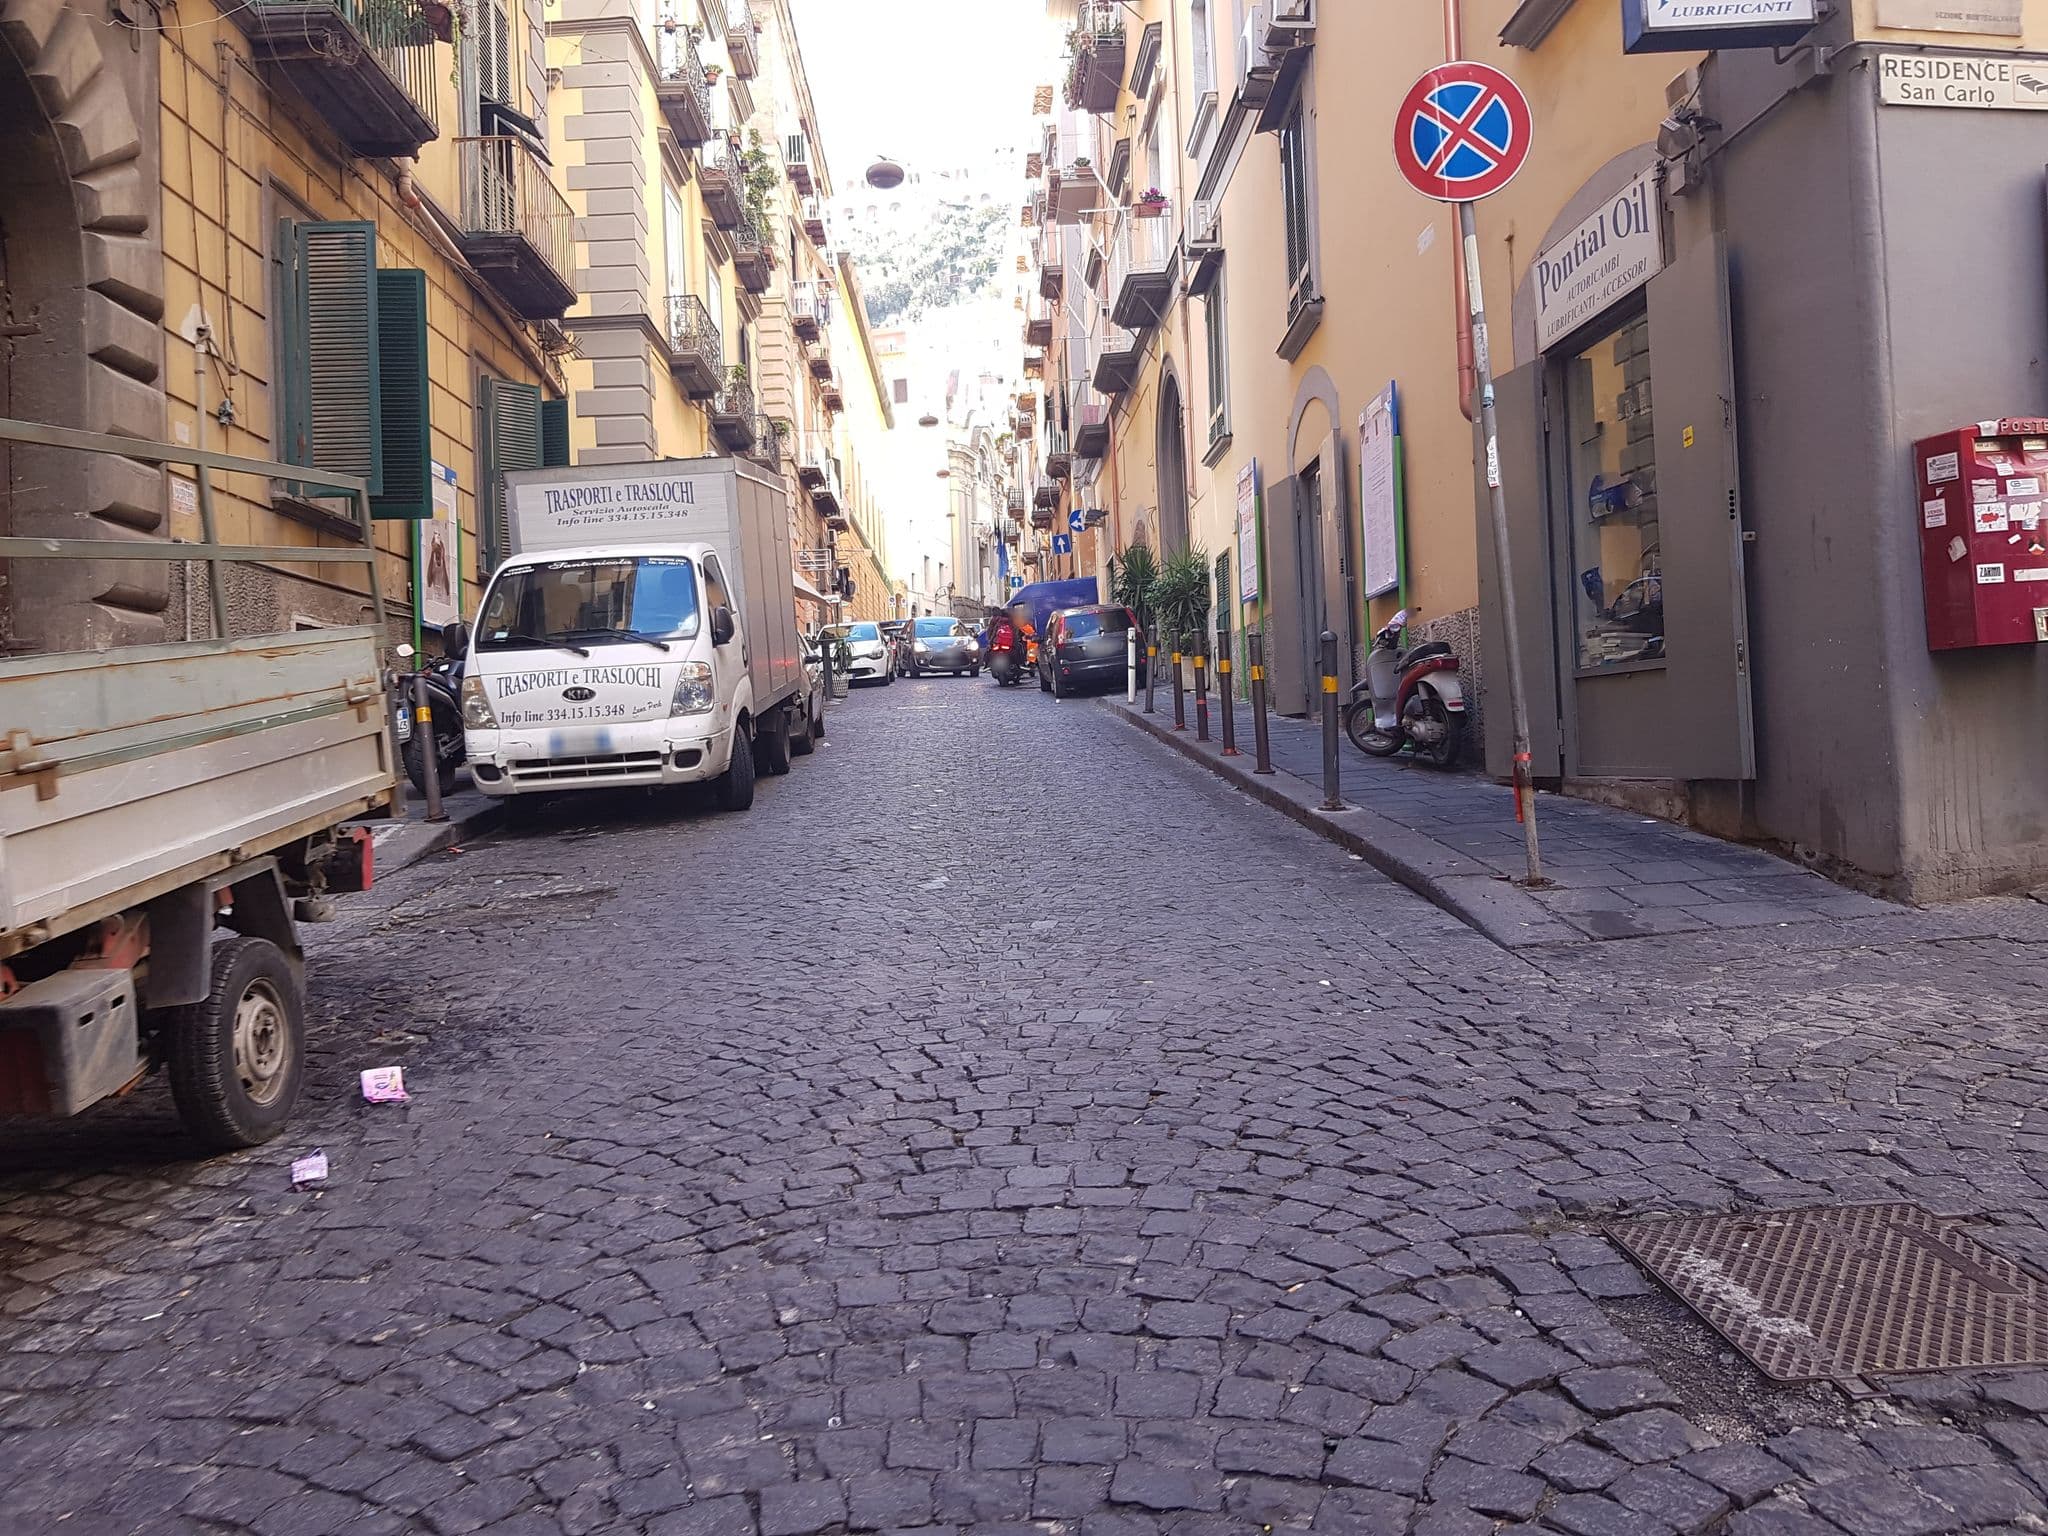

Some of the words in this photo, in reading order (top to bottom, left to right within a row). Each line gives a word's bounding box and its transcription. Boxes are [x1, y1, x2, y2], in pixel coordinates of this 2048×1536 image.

[1672, 1, 1792, 18] LUBRIFICANTI
[1885, 59, 2010, 82] RESIDENCE
[1900, 83, 1935, 100] San
[1944, 85, 1995, 103] Carlo
[1537, 214, 1607, 315] Pontial
[1612, 181, 1650, 239] Oil
[1567, 254, 1620, 303] AUTORICAMBI
[1547, 295, 1596, 337] LUBRIFICANTI
[1601, 257, 1647, 300] ACCESSORI
[544, 486, 612, 515] TRASPORTI
[616, 490, 622, 502] e
[625, 481, 695, 505] TRASLOCHI
[572, 507, 614, 516] Servizio
[617, 503, 670, 513] Autoscala
[557, 518, 580, 527] Info
[583, 515, 604, 524] line
[608, 509, 689, 523] 334.15.15.348
[496, 670, 569, 699] TRASPORTI
[572, 674, 579, 685] e
[582, 666, 662, 689] TRASLOCHI
[567, 689, 591, 700] KIA
[500, 711, 522, 727] Info
[524, 709, 544, 722] line
[547, 704, 625, 722] 334.15.15.348
